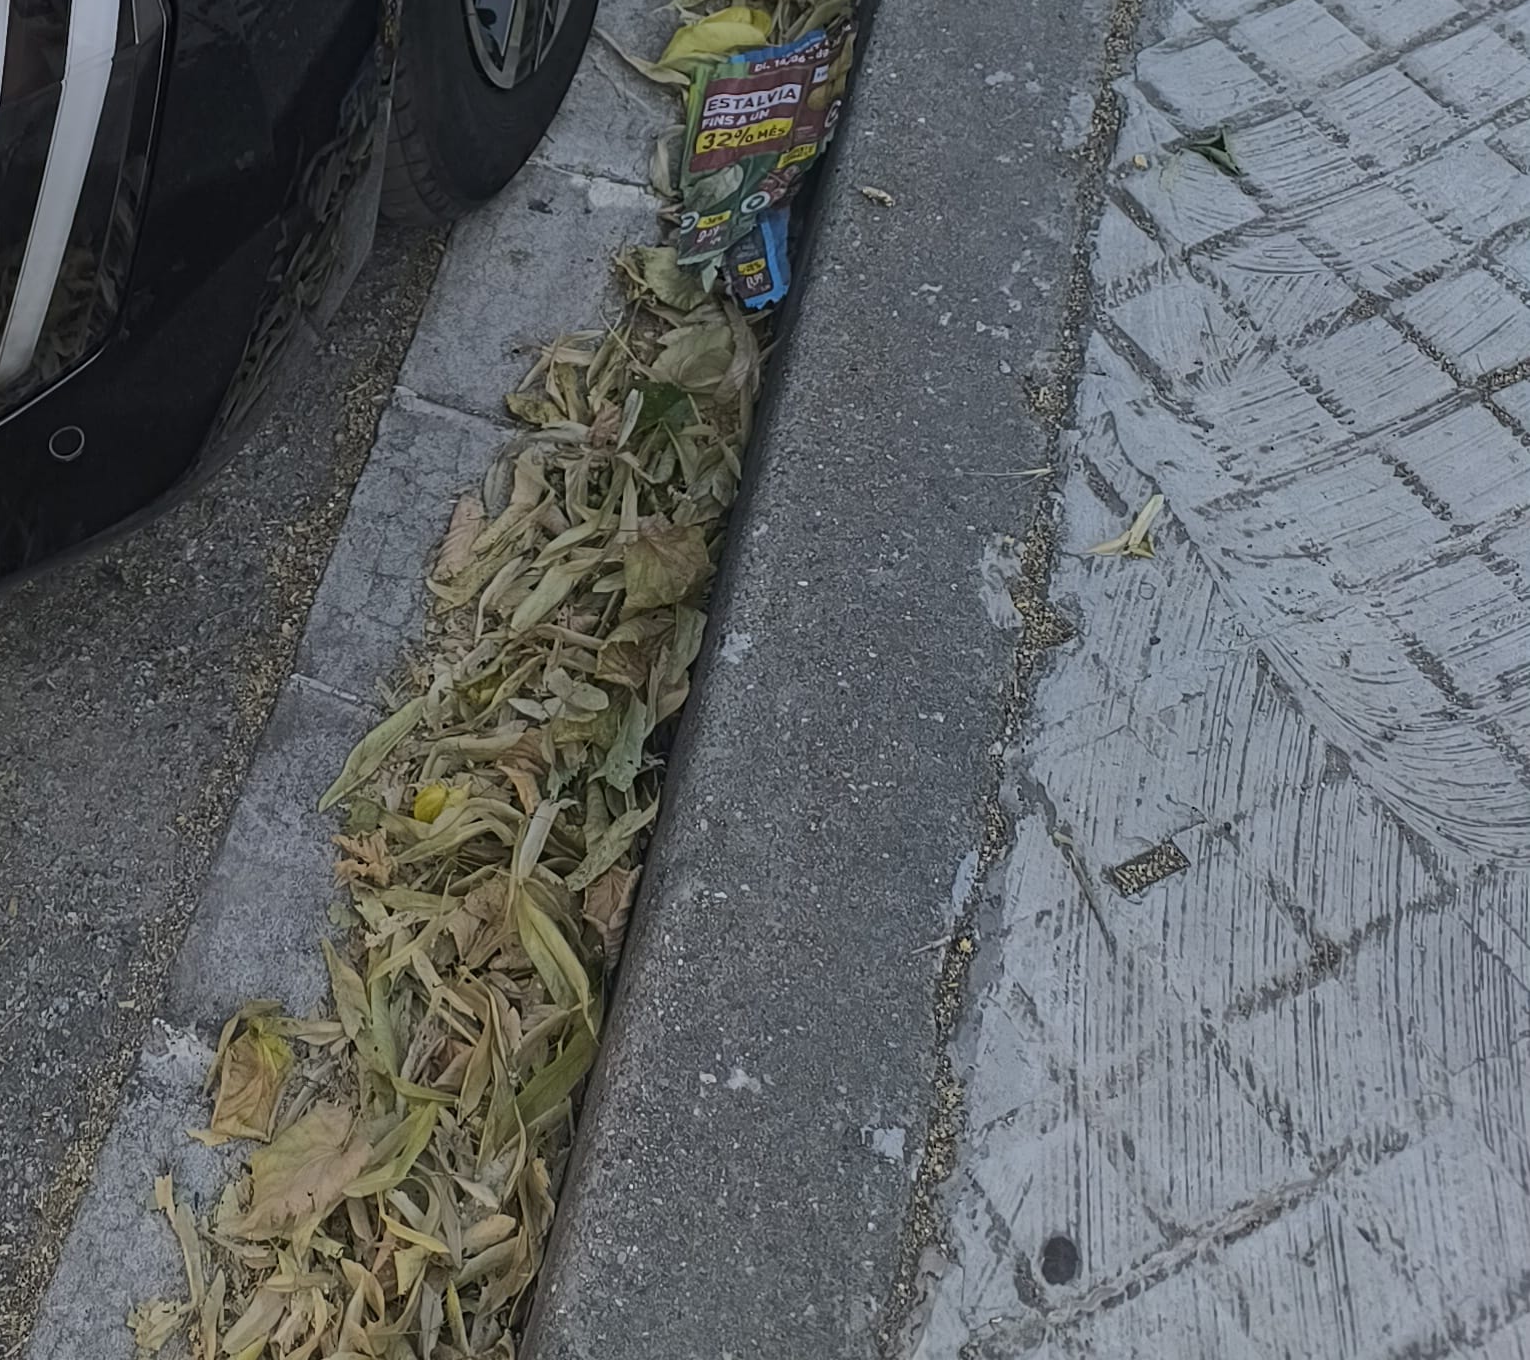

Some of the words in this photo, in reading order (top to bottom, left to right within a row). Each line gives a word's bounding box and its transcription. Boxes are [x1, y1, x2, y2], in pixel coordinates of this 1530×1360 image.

[706, 87, 797, 112] ESTALVIA
[701, 114, 735, 130] FINS
[736, 114, 748, 127] A
[749, 108, 771, 122] UN
[701, 126, 754, 150] 32%
